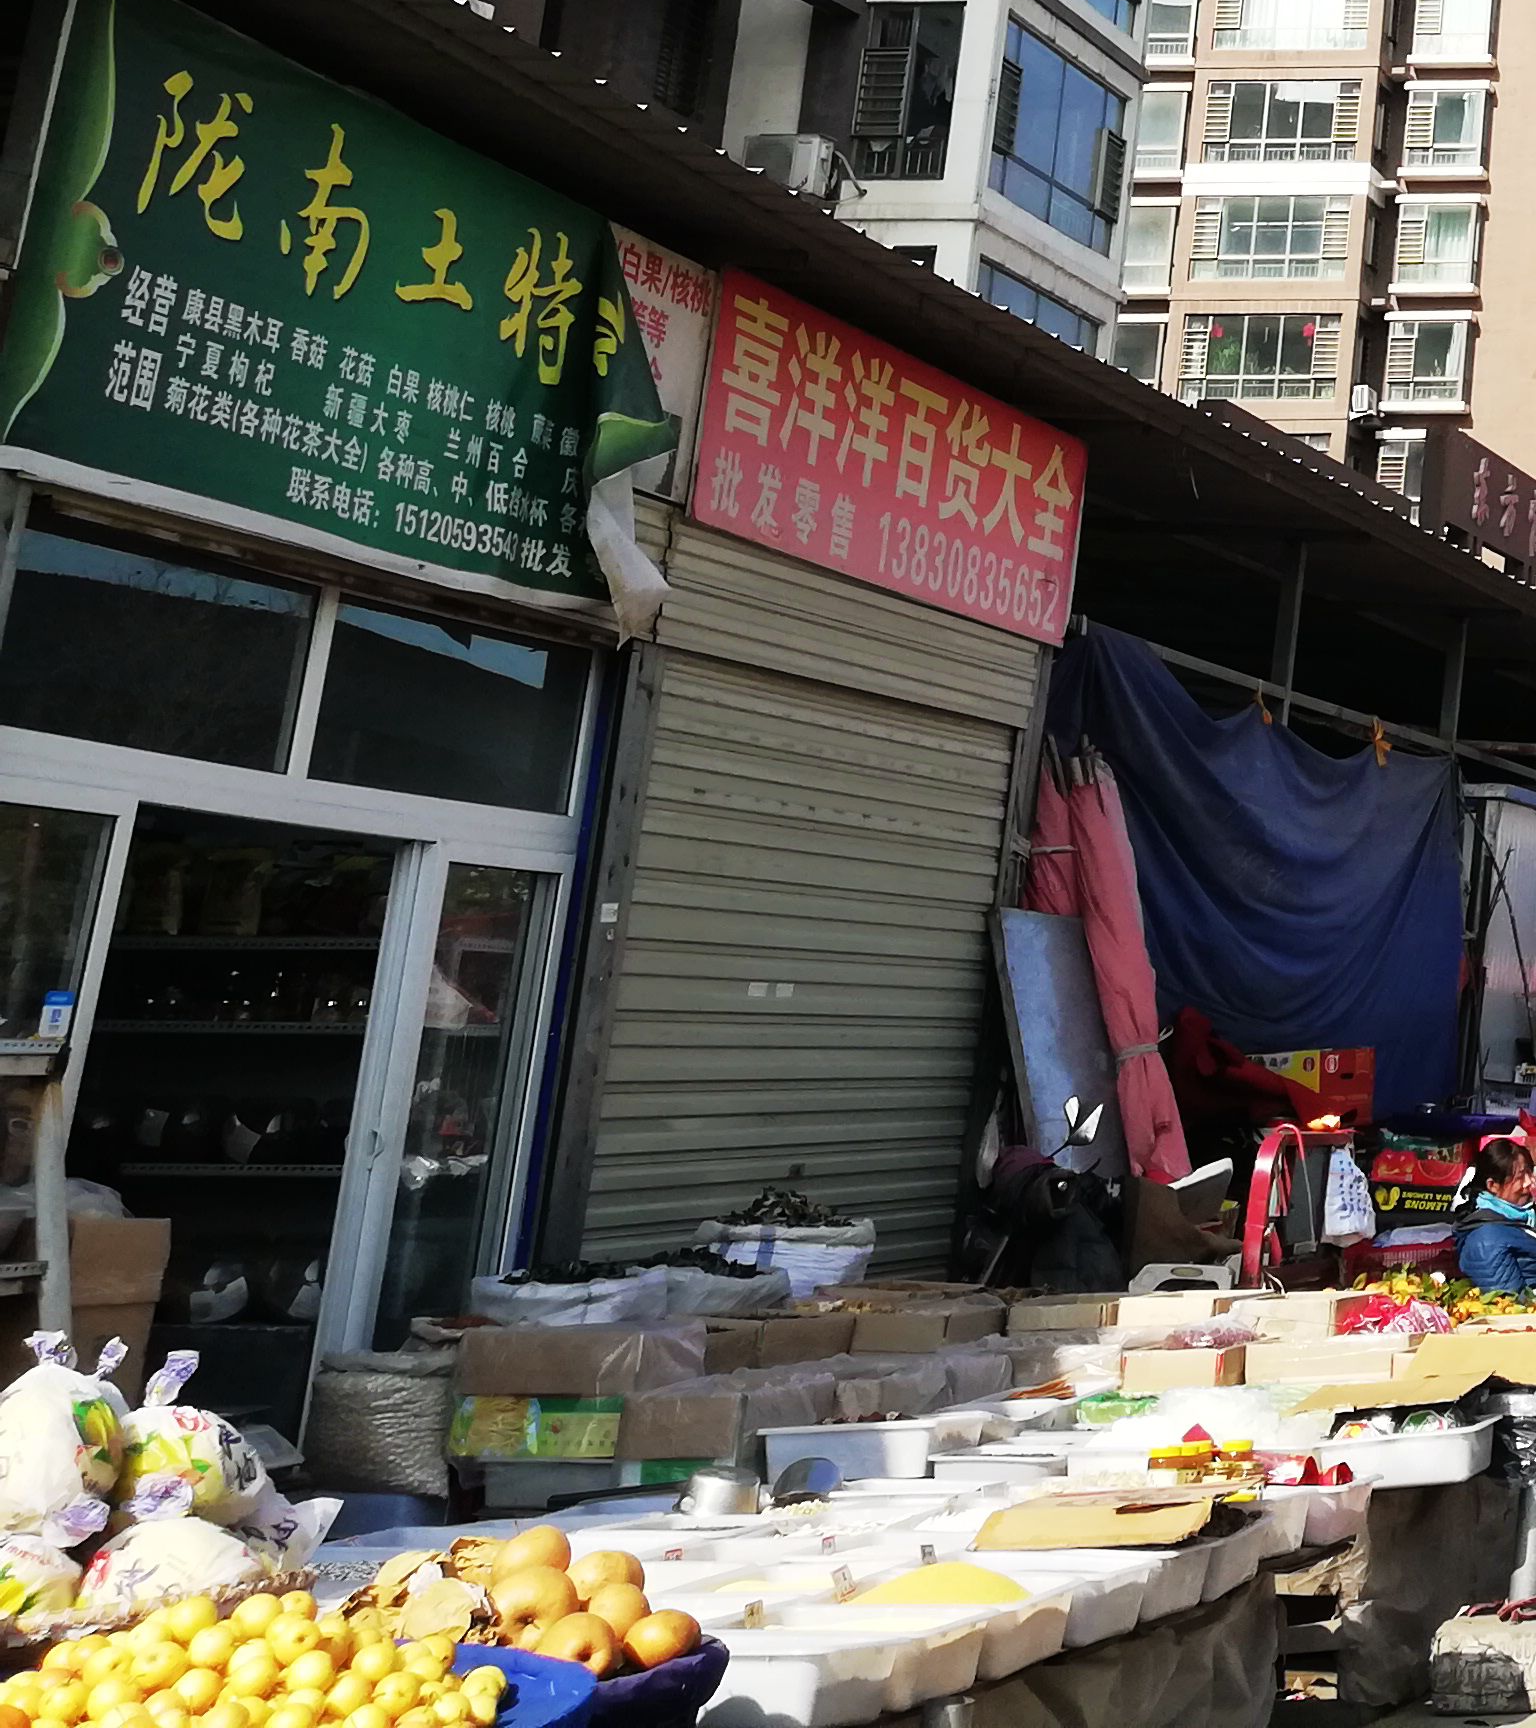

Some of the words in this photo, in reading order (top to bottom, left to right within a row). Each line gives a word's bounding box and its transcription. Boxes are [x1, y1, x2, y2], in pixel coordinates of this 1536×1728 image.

[121, 265, 178, 336] 经营
[182, 288, 284, 354] 康县黑木耳
[289, 327, 328, 370] 香菇
[338, 345, 376, 388] 花菇
[386, 364, 420, 403] 白果
[426, 378, 475, 422] 核桃仁
[485, 398, 515, 439] 核桃
[104, 339, 163, 412] 范围
[176, 333, 276, 397] 宁夏枸杞
[322, 383, 413, 444] 新疆大枣
[443, 427, 529, 480] 兰州百合
[722, 294, 1074, 562] 喜洋洋百货大全
[520, 536, 572, 578] 批发
[710, 447, 857, 560] 批发零售
[877, 512, 1061, 633] 13830835652
